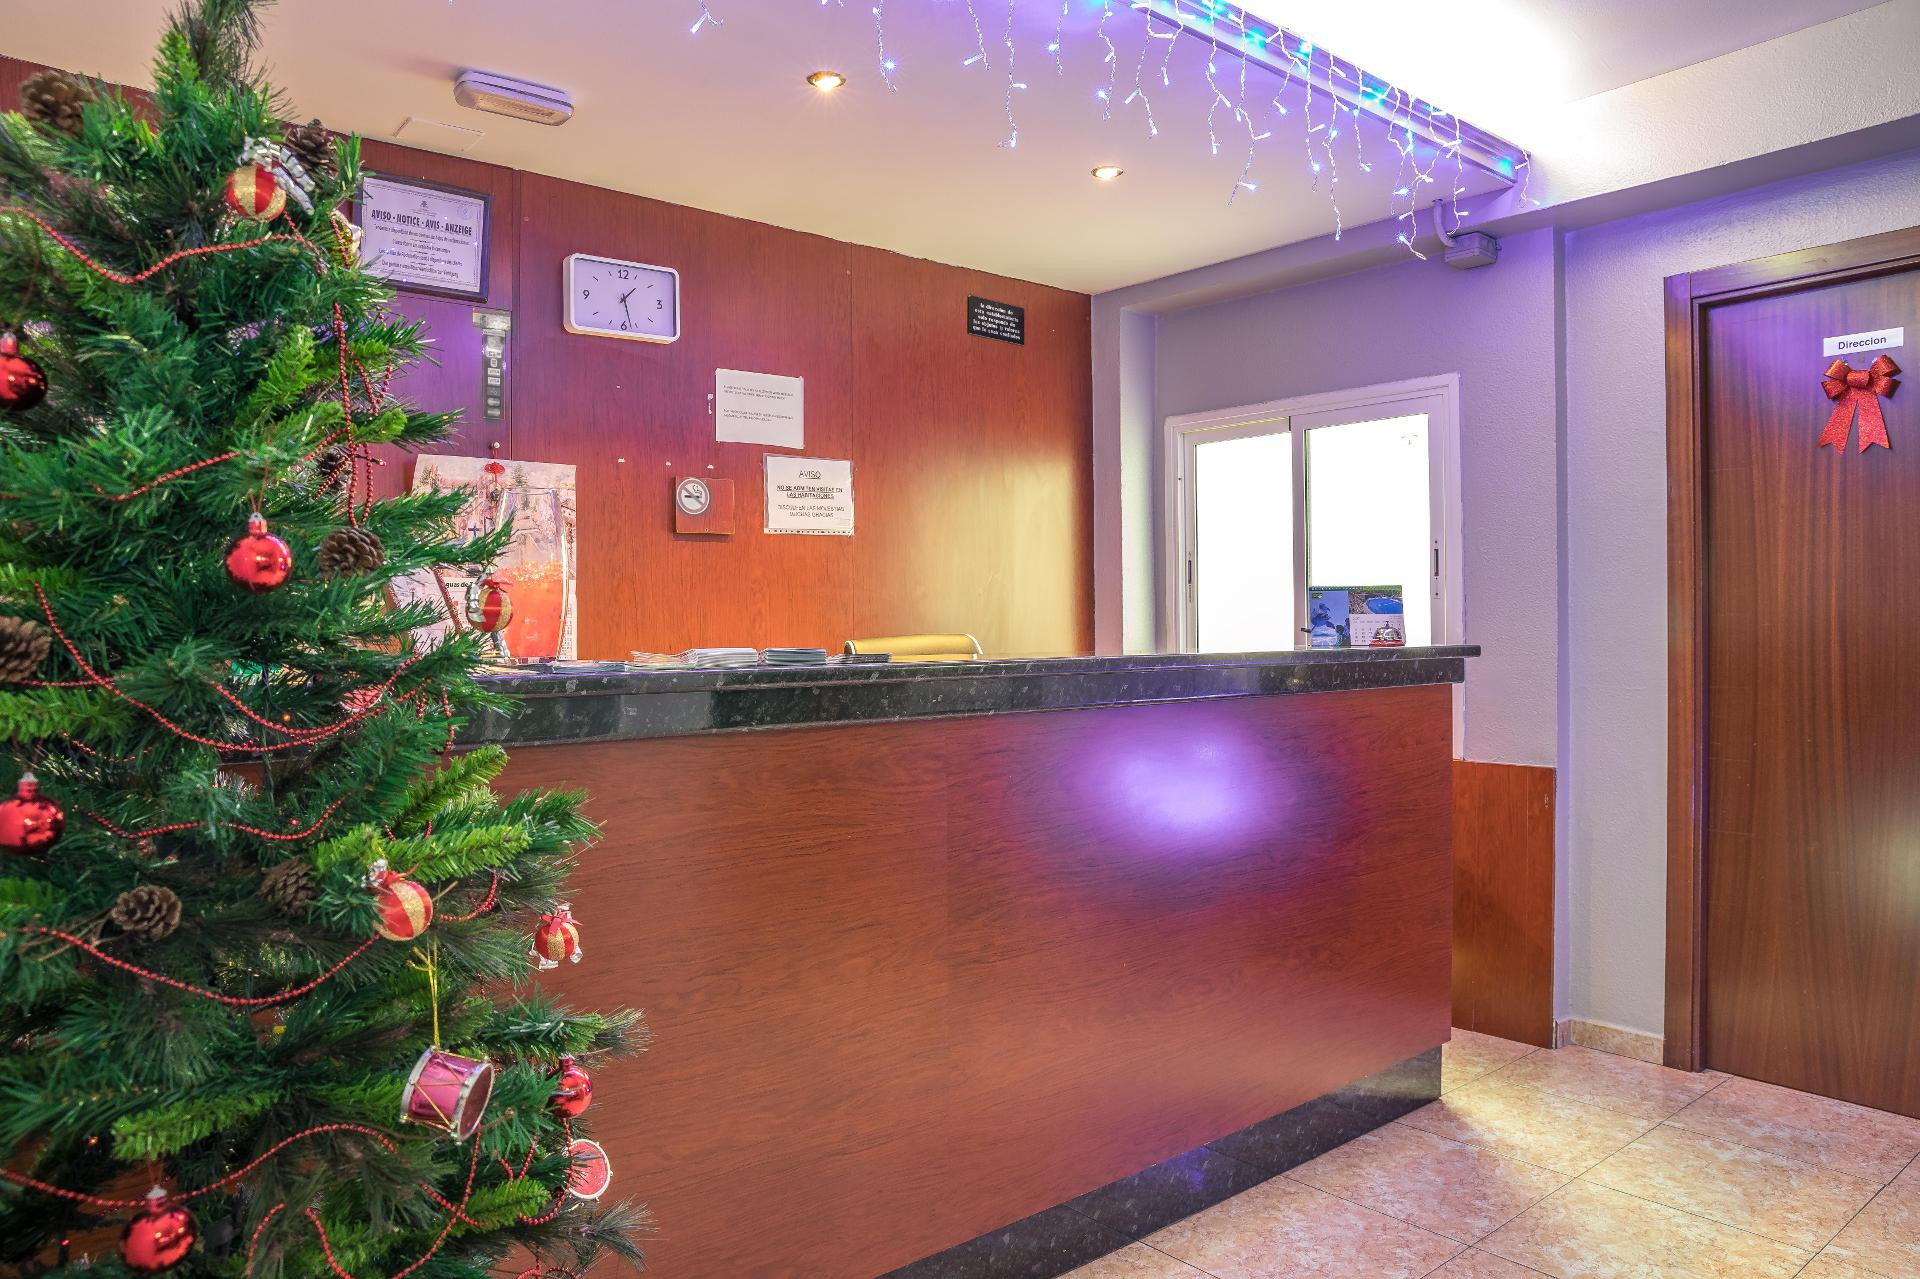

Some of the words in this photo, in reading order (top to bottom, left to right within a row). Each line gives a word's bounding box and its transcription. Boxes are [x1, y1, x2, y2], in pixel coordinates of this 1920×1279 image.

[371, 209, 392, 220] AVISO
[397, 214, 420, 227] NOTICE
[425, 218, 440, 230] AVIS
[445, 222, 472, 236] ANZEIGE
[617, 270, 629, 279] 12
[582, 289, 590, 300] 9
[656, 300, 663, 310] 3
[620, 321, 628, 331] 6
[1838, 336, 1887, 350] Direccion
[798, 470, 821, 479] AVISO
